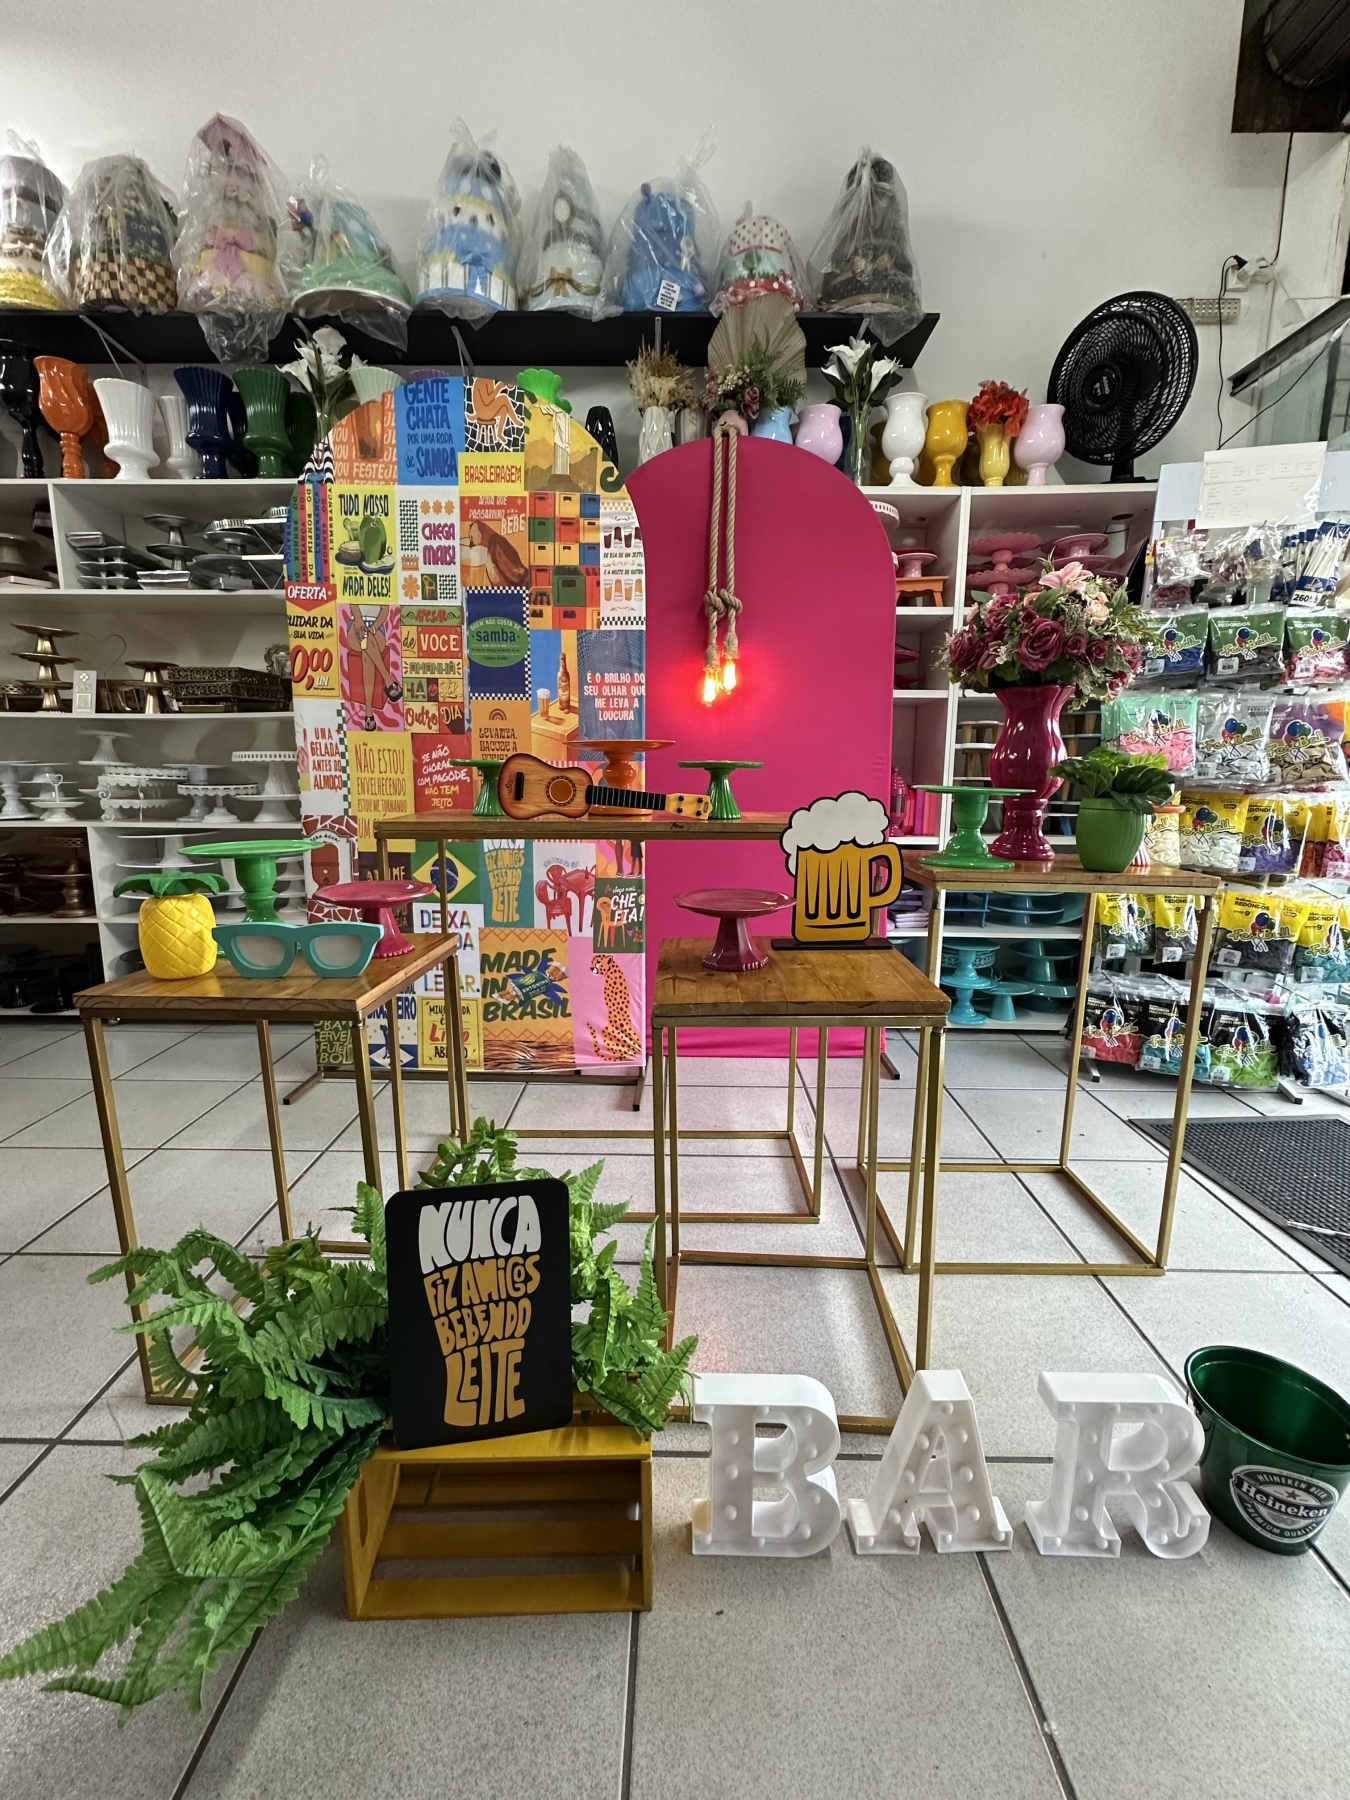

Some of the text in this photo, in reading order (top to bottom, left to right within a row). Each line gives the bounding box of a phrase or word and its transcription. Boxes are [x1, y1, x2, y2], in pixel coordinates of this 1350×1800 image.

[406, 405, 450, 430] CHATA
[407, 432, 453, 445] POR UMA RODA
[405, 446, 458, 478] de SAMBA
[307, 489, 312, 502] DO
[338, 494, 389, 516] TUDO NOSSO
[422, 522, 456, 540] CHEGA
[500, 513, 526, 536] BEBE
[422, 544, 456, 566] MAIS!
[309, 564, 314, 577] DA
[287, 585, 327, 600] OFERTA
[342, 576, 390, 598] NADA DELES!
[320, 616, 334, 628] DA
[293, 631, 324, 640] SUA VIDA
[476, 628, 516, 642] samba
[316, 675, 329, 686] UN
[587, 670, 645, 683] É O BRILHO DO
[584, 686, 646, 696] SEU OLHAR QUE
[595, 698, 639, 708] ME LEVA A
[440, 704, 462, 724] DIA
[599, 710, 634, 721] LOUCURA
[314, 727, 333, 740] UMA
[310, 741, 340, 757] GELADA
[422, 743, 450, 763] SE NÃO
[512, 742, 518, 752] A
[312, 760, 342, 772] ANTES DO
[355, 742, 405, 774] NÃO ESTOU
[313, 774, 343, 792] ALMOÇO
[417, 777, 430, 786] COM
[432, 768, 470, 784] PAGODE,
[357, 777, 406, 796] ENVELHECENDO
[425, 783, 459, 795] NÃO TEM
[432, 798, 453, 808] JEITO
[358, 818, 370, 838] UM
[492, 886, 519, 922] LEITE
[610, 892, 637, 910] CHE
[1234, 901, 1270, 910] REDONDOS
[614, 906, 644, 926] FIA!
[483, 997, 572, 1022] BRASIL
[418, 1194, 542, 1274] NUNCA
[434, 1297, 532, 1356] BEBENDO
[444, 1338, 526, 1427] LEITE
[692, 1370, 1212, 1559] BAR
[1257, 1474, 1307, 1489] HEINEKEN
[1240, 1480, 1328, 1518] Heineken
[1244, 1502, 1280, 1535] PREMIUM
[1284, 1522, 1318, 1537] QUALITY
